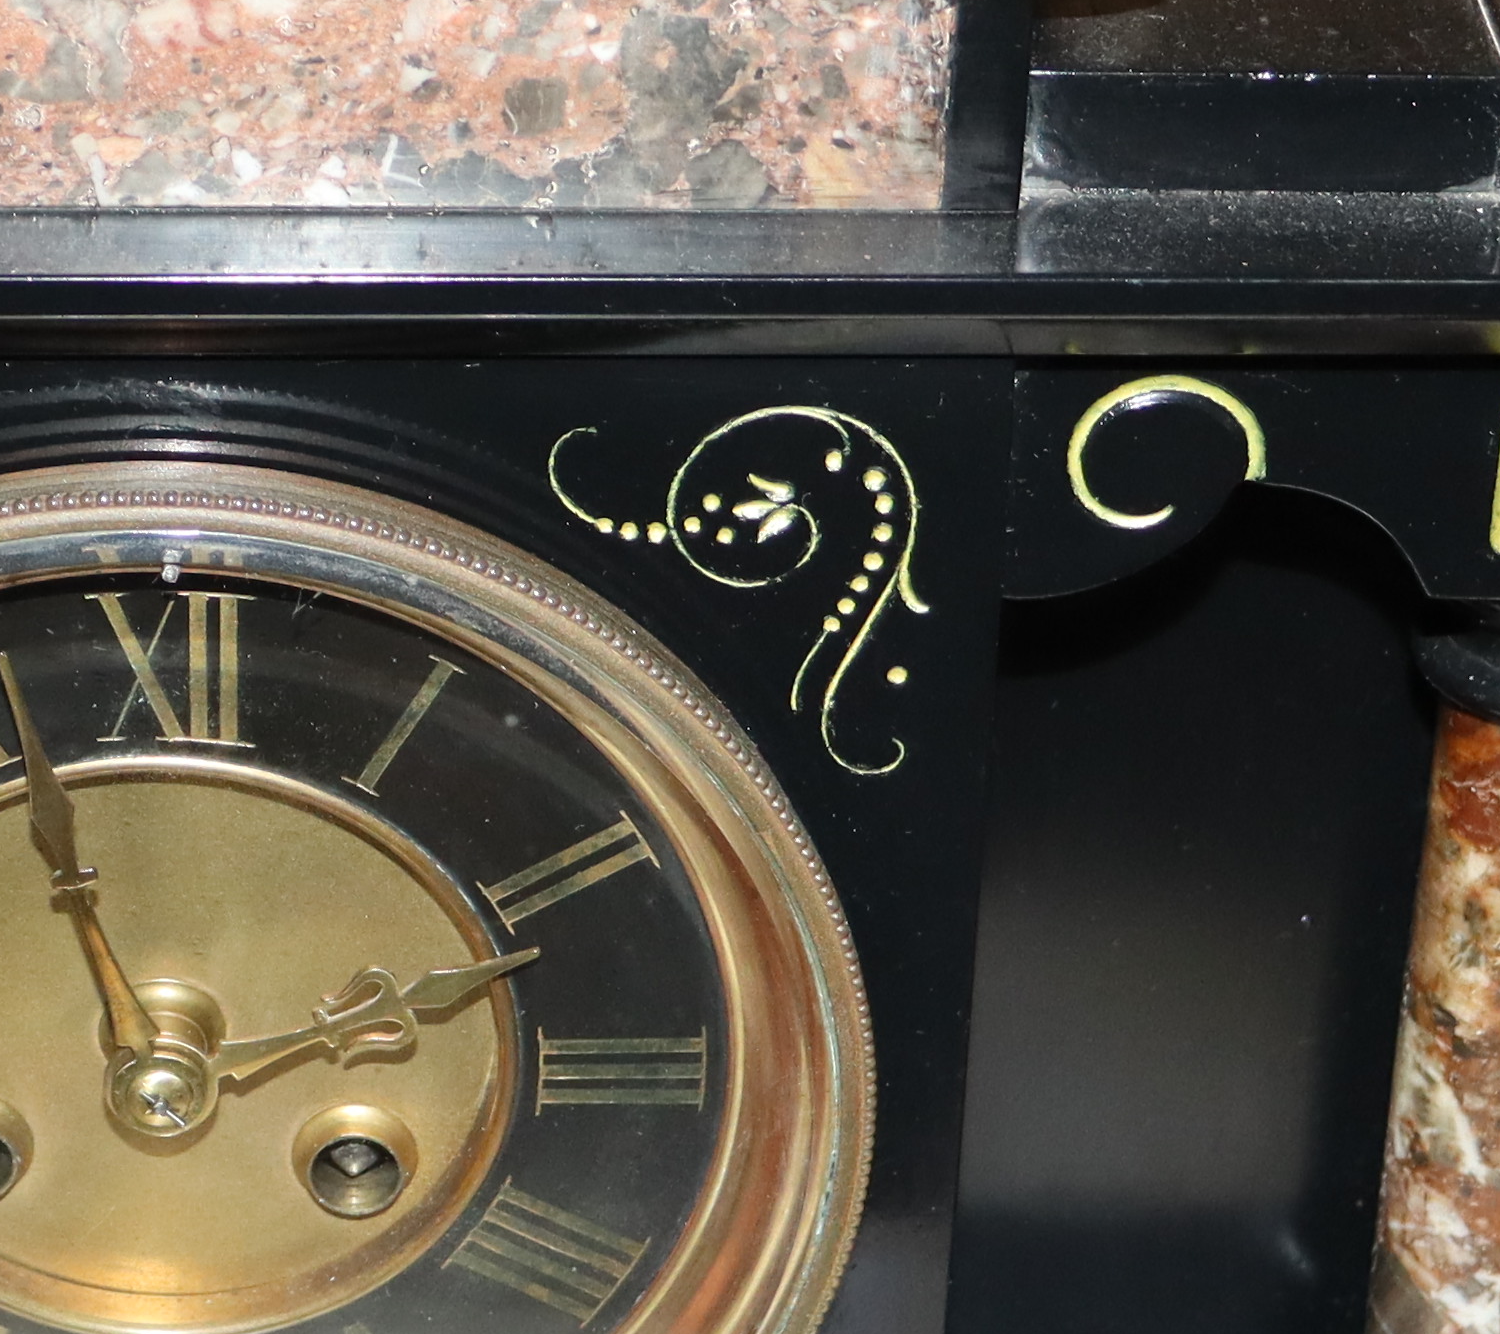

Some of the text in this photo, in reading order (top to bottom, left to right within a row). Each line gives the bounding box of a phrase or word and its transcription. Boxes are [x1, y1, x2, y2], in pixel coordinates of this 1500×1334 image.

[87, 590, 257, 748] XII
[343, 653, 464, 796] I
[475, 808, 662, 935] II
[535, 1026, 707, 1114] III
[442, 1176, 651, 1327] IIII
